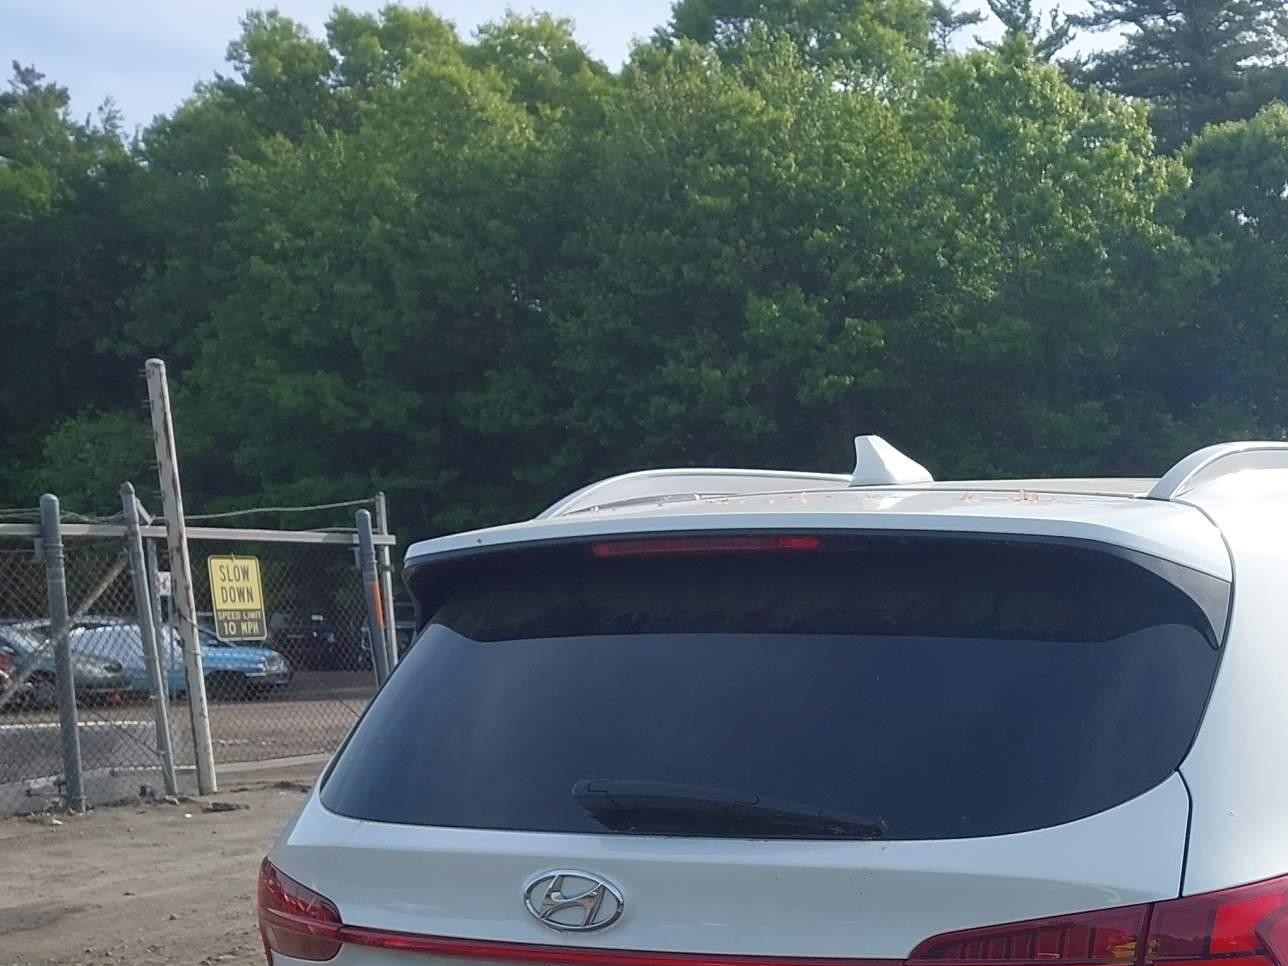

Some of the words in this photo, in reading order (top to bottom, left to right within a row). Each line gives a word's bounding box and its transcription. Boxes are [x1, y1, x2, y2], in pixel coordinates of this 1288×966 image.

[219, 565, 250, 582] SLOW
[221, 587, 254, 604] DOWN
[217, 611, 241, 621] SPEED
[242, 611, 260, 621] LIMIT
[223, 622, 236, 635] 10
[240, 621, 259, 635] MPH
